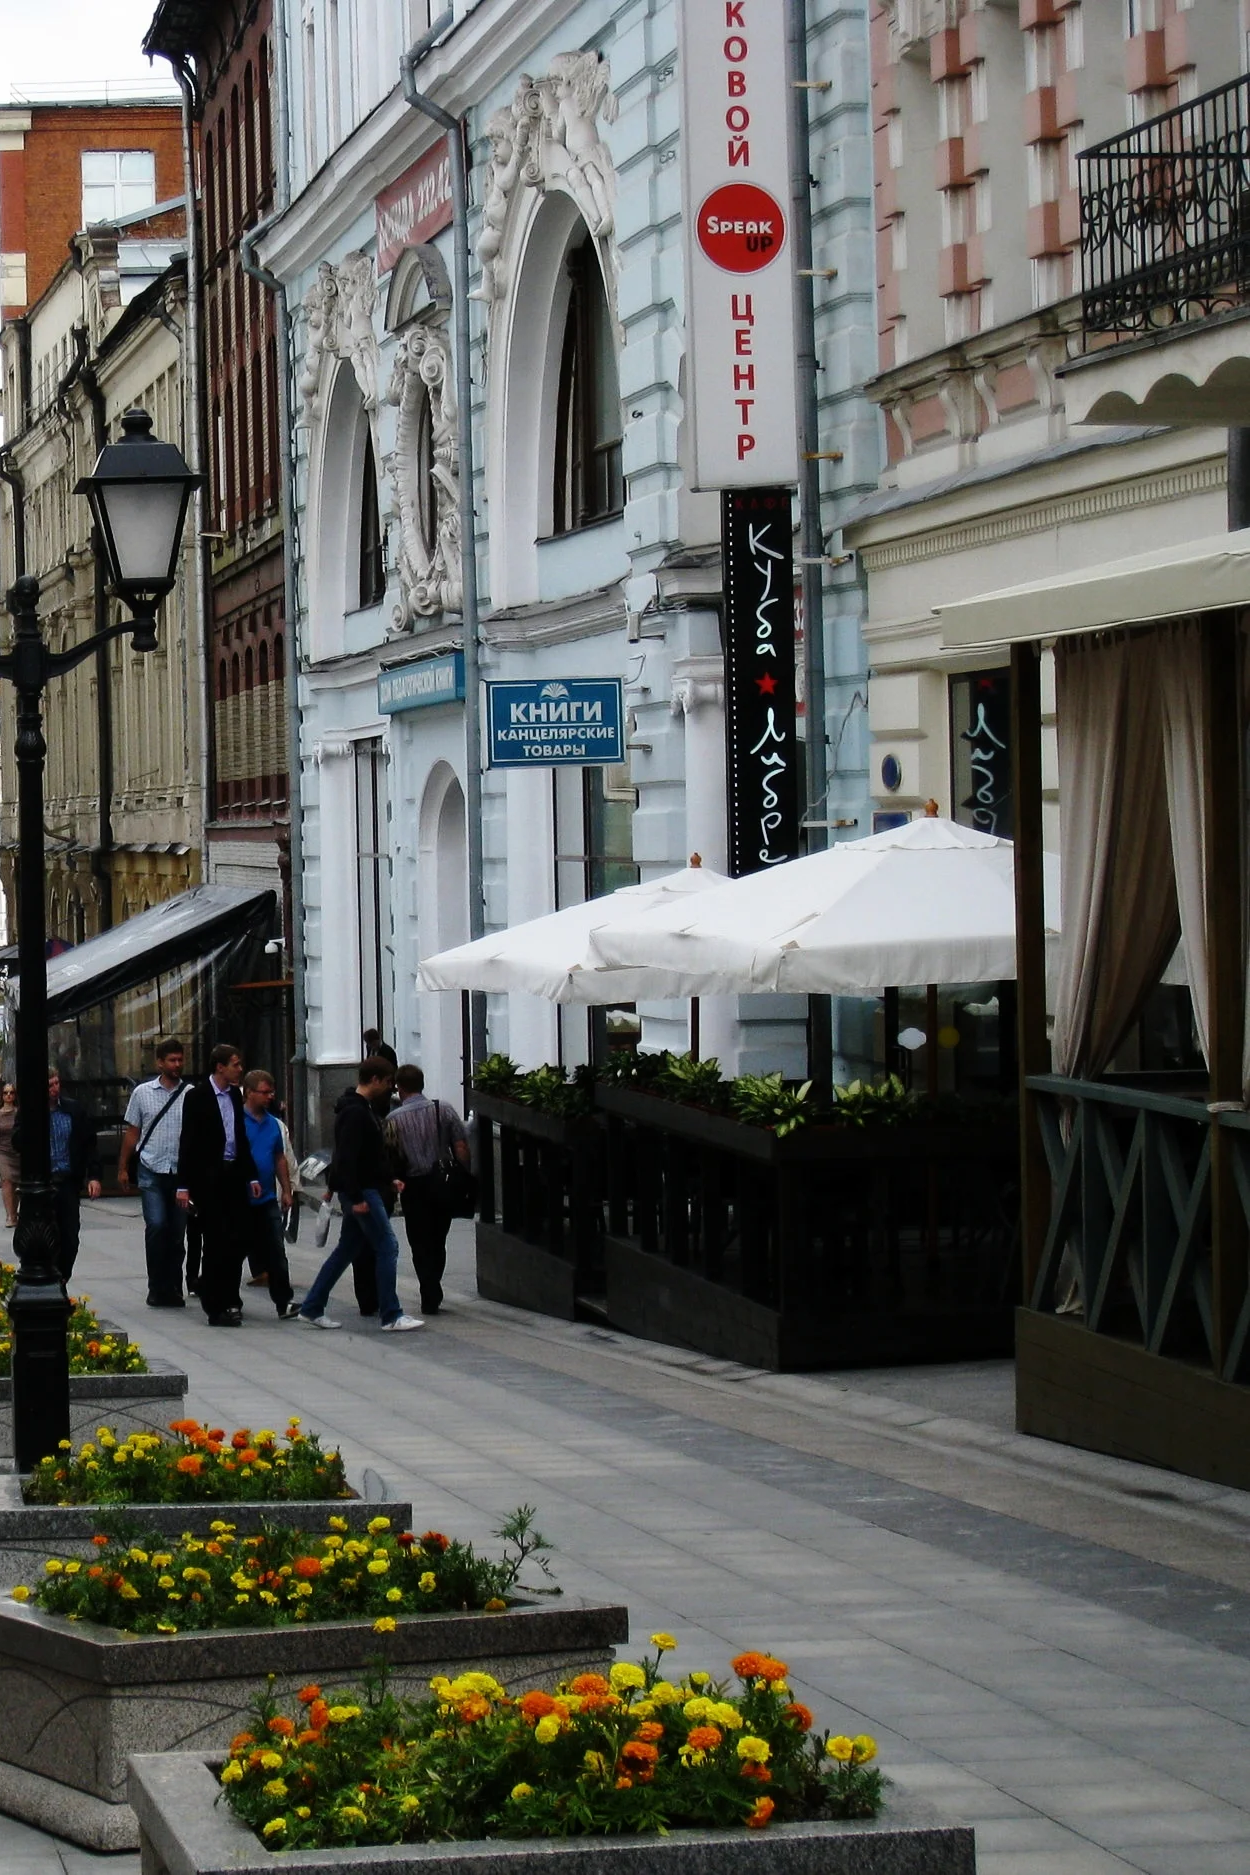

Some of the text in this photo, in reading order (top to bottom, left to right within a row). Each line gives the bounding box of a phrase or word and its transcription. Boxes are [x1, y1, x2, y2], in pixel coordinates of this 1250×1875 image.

[724, 2, 749, 167] КОВОЙ
[746, 236, 773, 253] UP
[731, 294, 755, 461] ЦЕНТР
[510, 701, 602, 723] КНИГИ
[497, 727, 615, 742] КАНЦЕЛЯРСКИЕ
[523, 744, 586, 757] ТОВАРЫ
